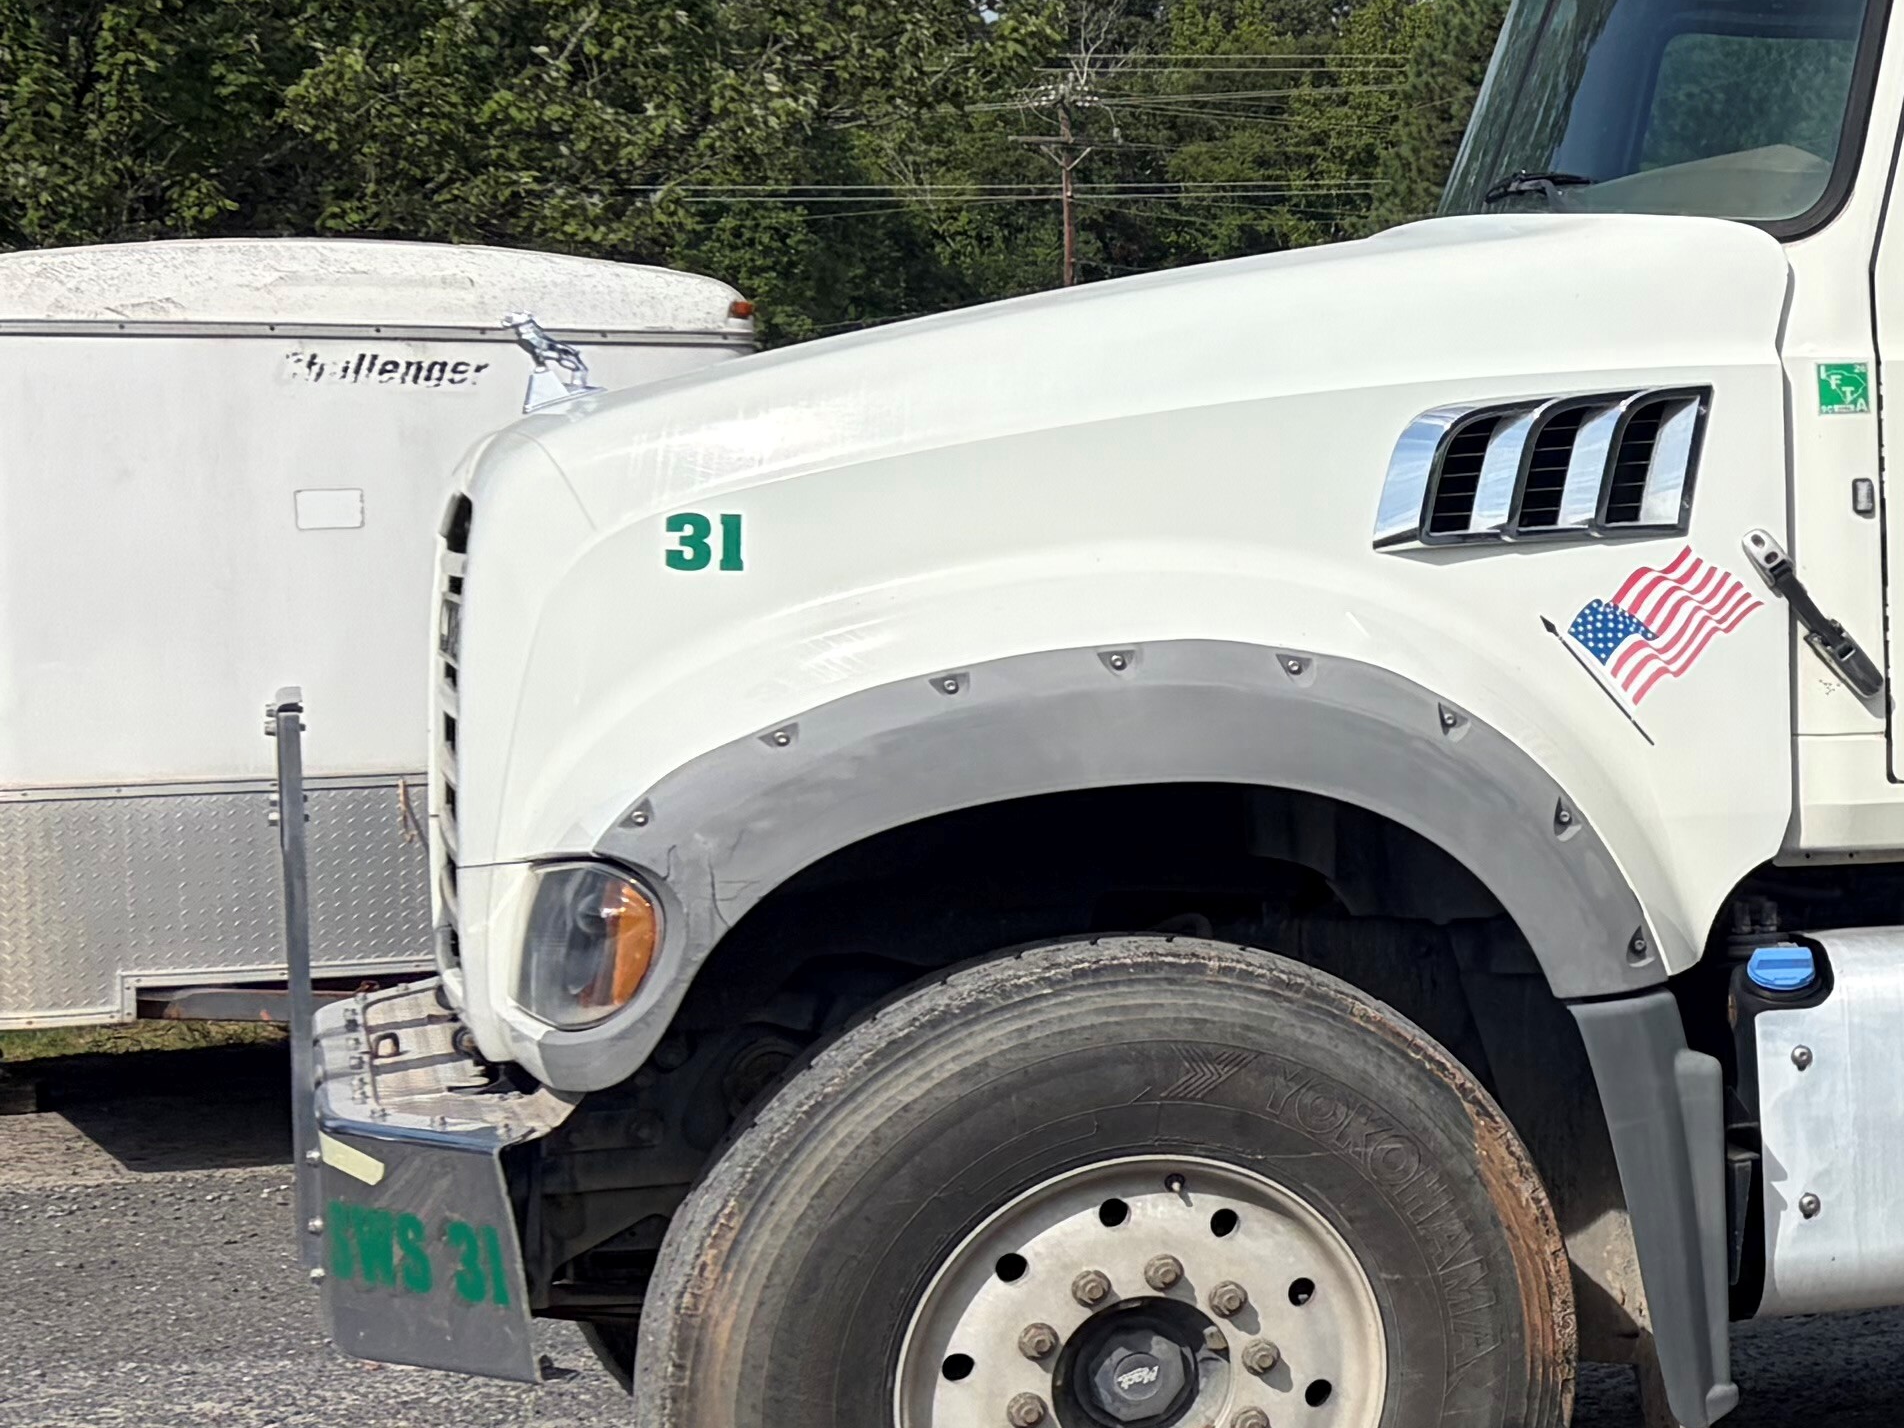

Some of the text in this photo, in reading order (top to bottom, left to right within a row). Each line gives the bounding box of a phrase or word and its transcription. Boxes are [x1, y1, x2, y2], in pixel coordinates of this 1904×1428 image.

[665, 512, 744, 571] 31
[448, 1220, 511, 1307] 31
[1265, 1064, 1502, 1397] YOKOHAMA
